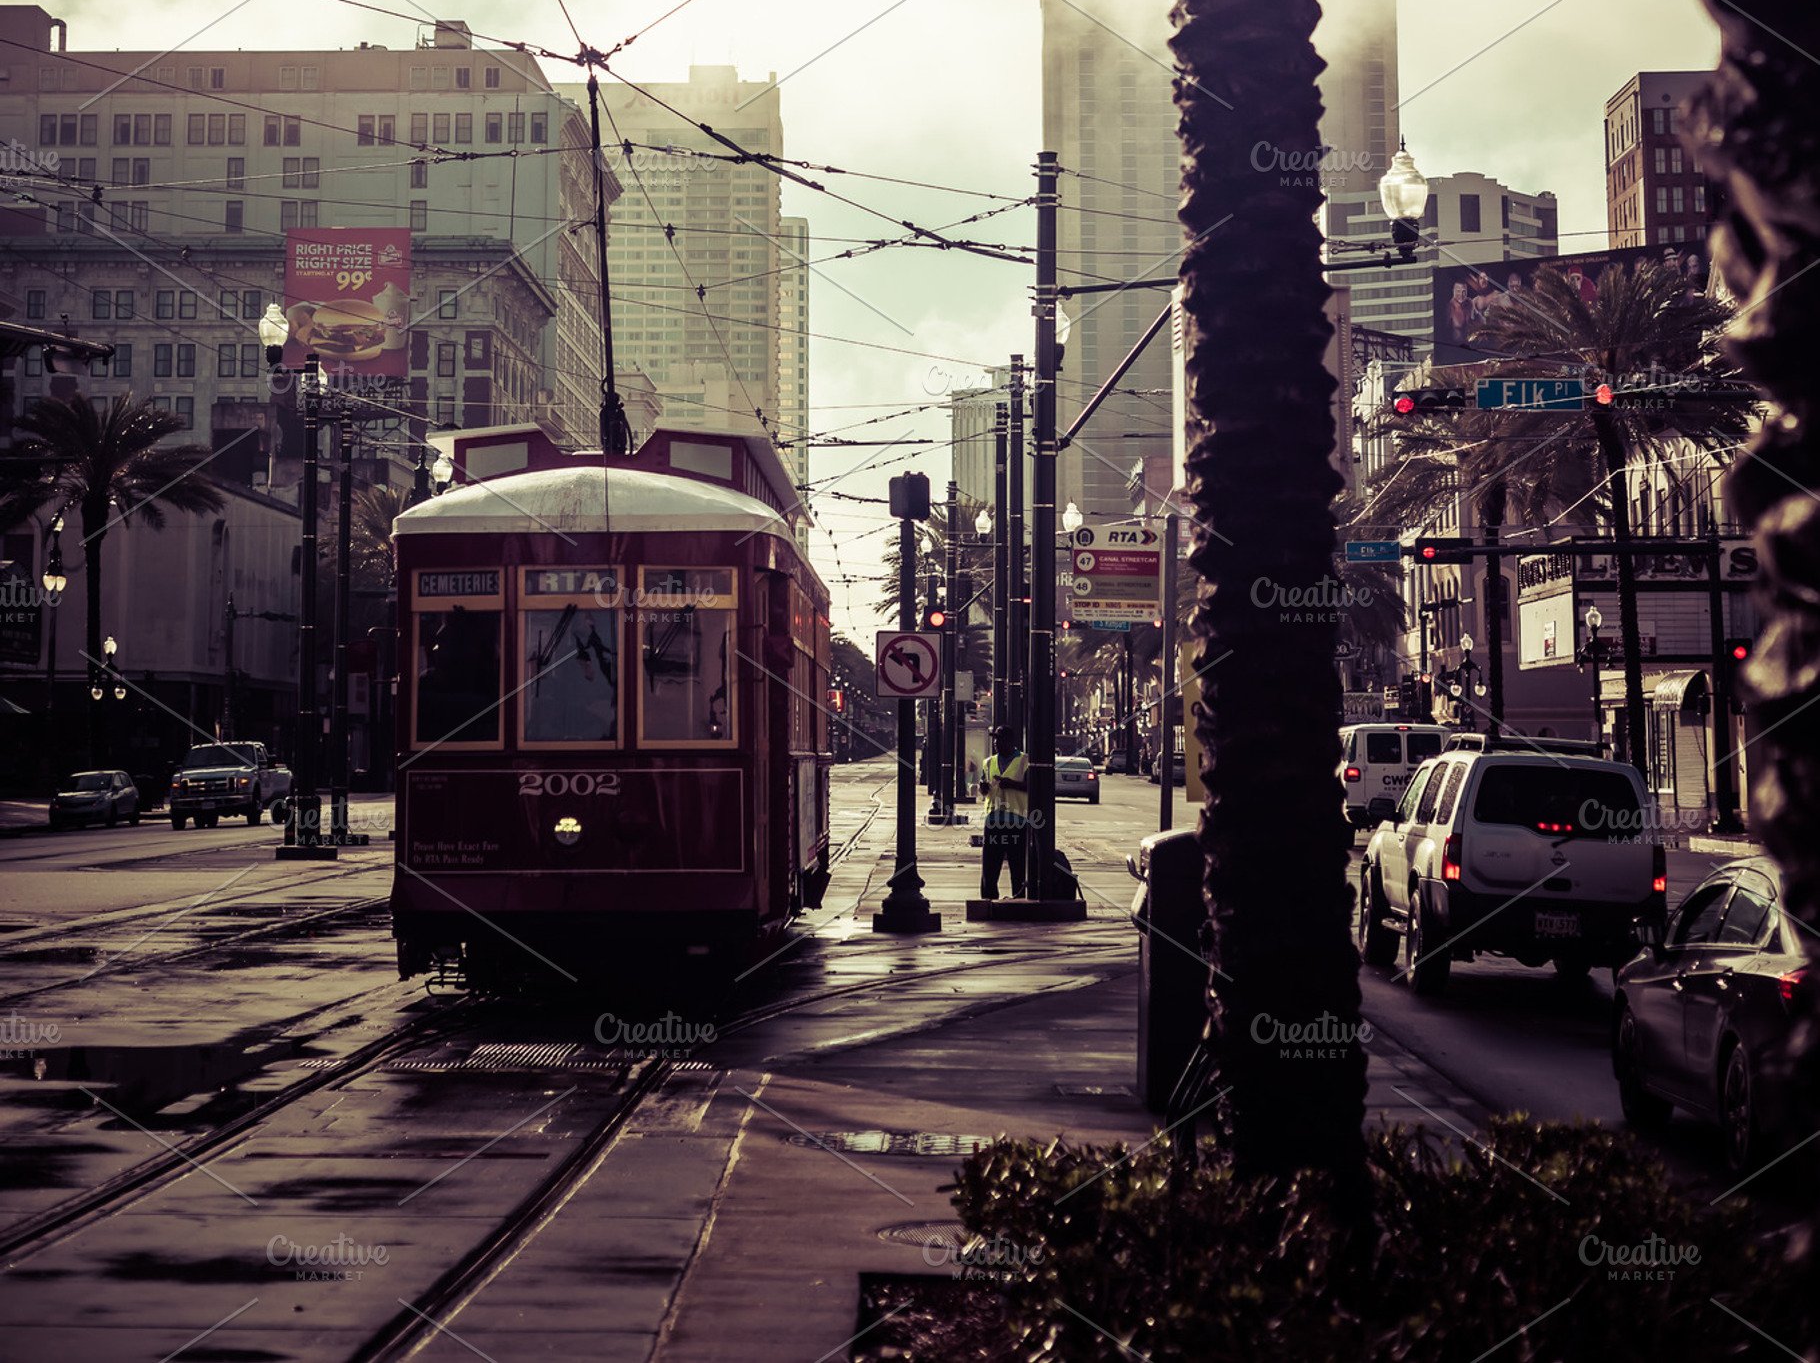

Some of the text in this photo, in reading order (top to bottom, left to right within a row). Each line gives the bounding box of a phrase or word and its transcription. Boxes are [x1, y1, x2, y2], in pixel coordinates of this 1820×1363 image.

[295, 244, 373, 255] RIGHT PRICE
[295, 257, 340, 269] RIGHT
[341, 257, 372, 269] SIZE
[335, 271, 373, 291] 99¢
[1502, 380, 1569, 410] Elk Pl
[1108, 531, 1138, 543] RTA
[1079, 557, 1092, 566] 47
[420, 572, 501, 595] CEMETERIES
[538, 572, 601, 593] RTA
[1075, 583, 1088, 591] 48
[518, 773, 621, 796] 2002
